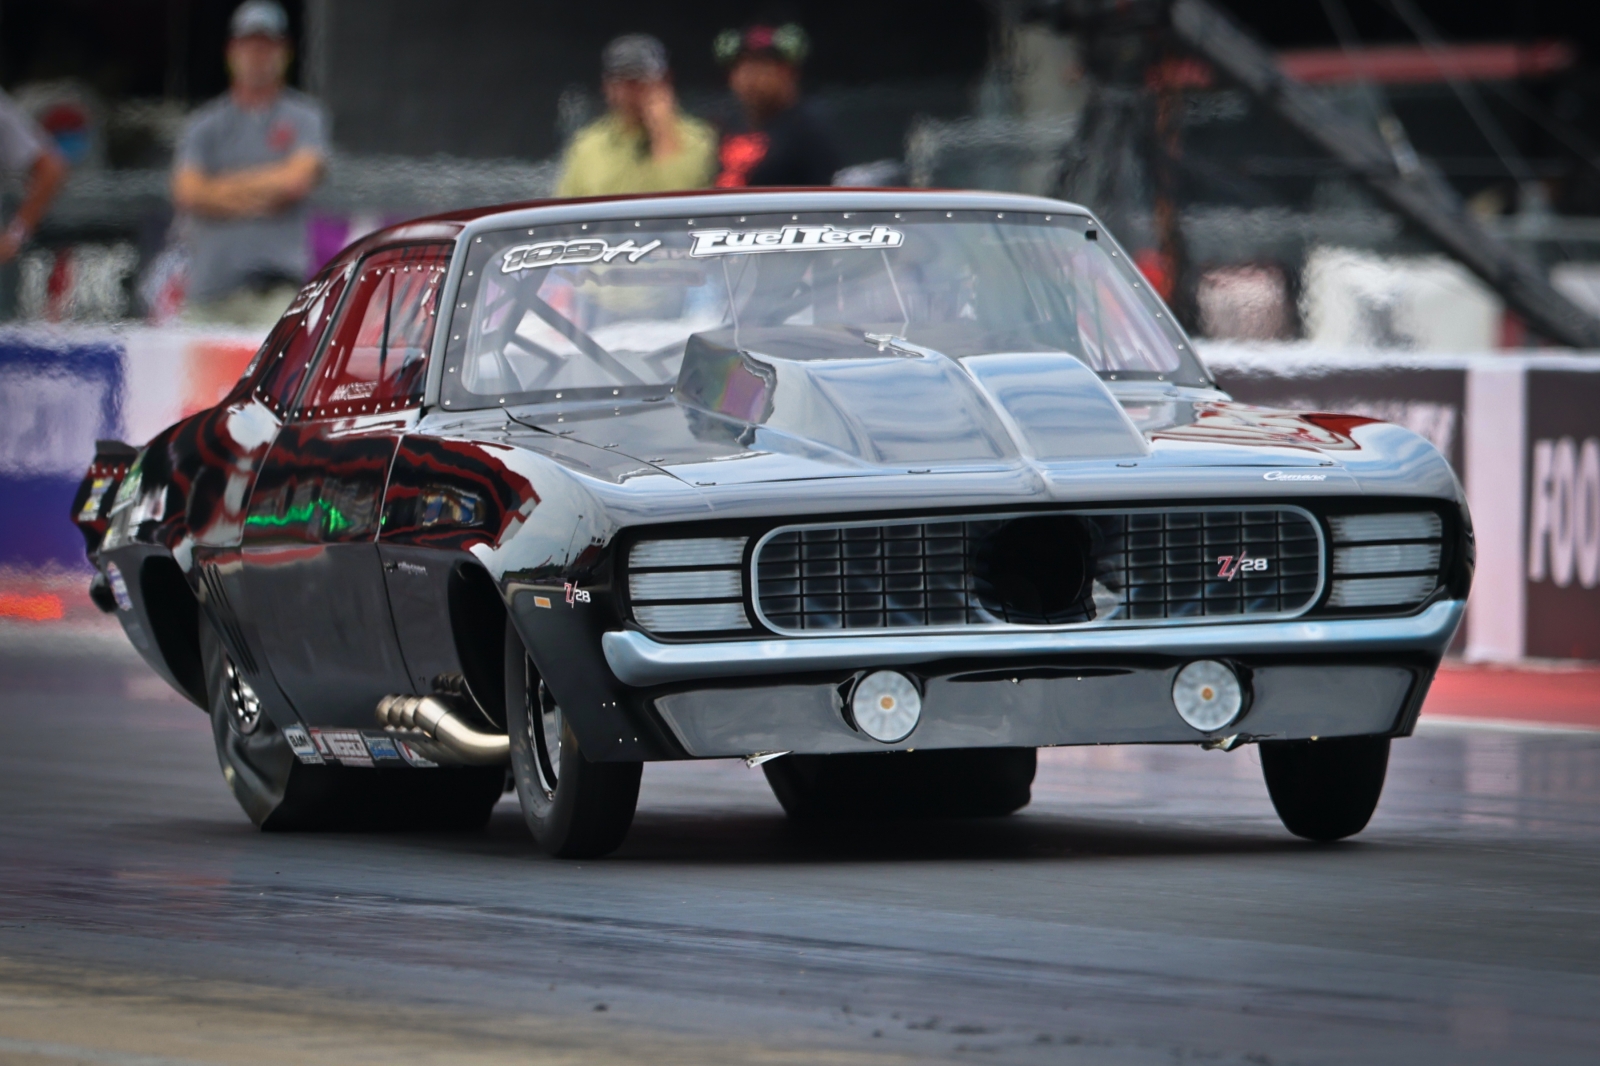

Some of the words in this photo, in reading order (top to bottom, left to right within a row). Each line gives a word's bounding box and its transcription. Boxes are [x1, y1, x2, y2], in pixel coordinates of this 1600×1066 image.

[689, 226, 903, 256] FuelTech
[1263, 470, 1327, 481] Camaro
[1217, 551, 1268, 581] Z/28
[564, 581, 591, 608] Z/28
